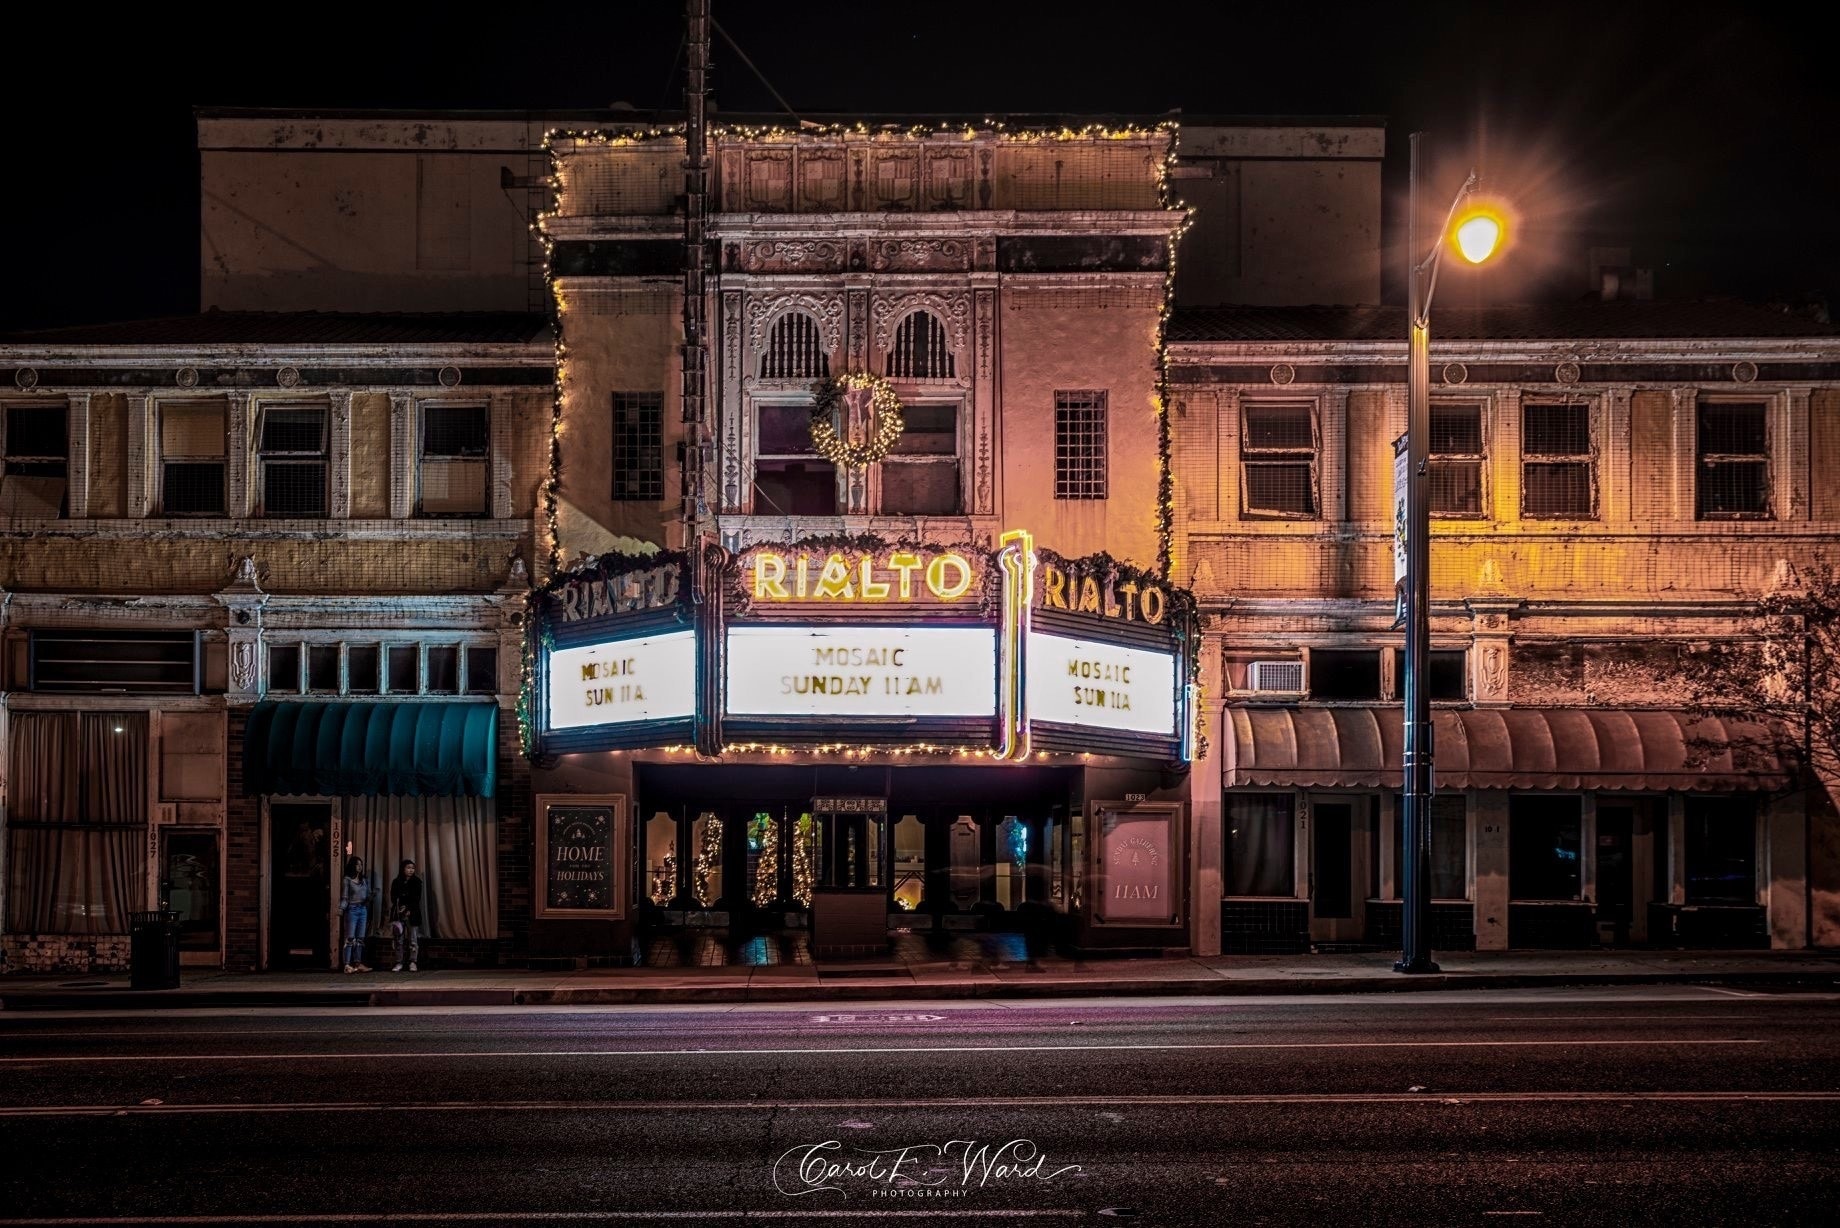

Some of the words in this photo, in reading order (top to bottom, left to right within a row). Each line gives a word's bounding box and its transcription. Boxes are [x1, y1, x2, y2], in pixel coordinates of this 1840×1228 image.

[754, 552, 972, 600] RIALTO
[562, 563, 680, 622] RIALTO
[1043, 564, 1165, 625] RIALTO
[581, 657, 636, 682] MOSAIC
[815, 649, 905, 667] MOSAIC
[1067, 658, 1131, 684] MOSAIC
[584, 686, 614, 707] SUN
[780, 676, 872, 695] SUNDAY
[1073, 686, 1105, 709] SUN
[557, 846, 606, 861] HOME
[557, 871, 605, 881] HOLIDAYS
